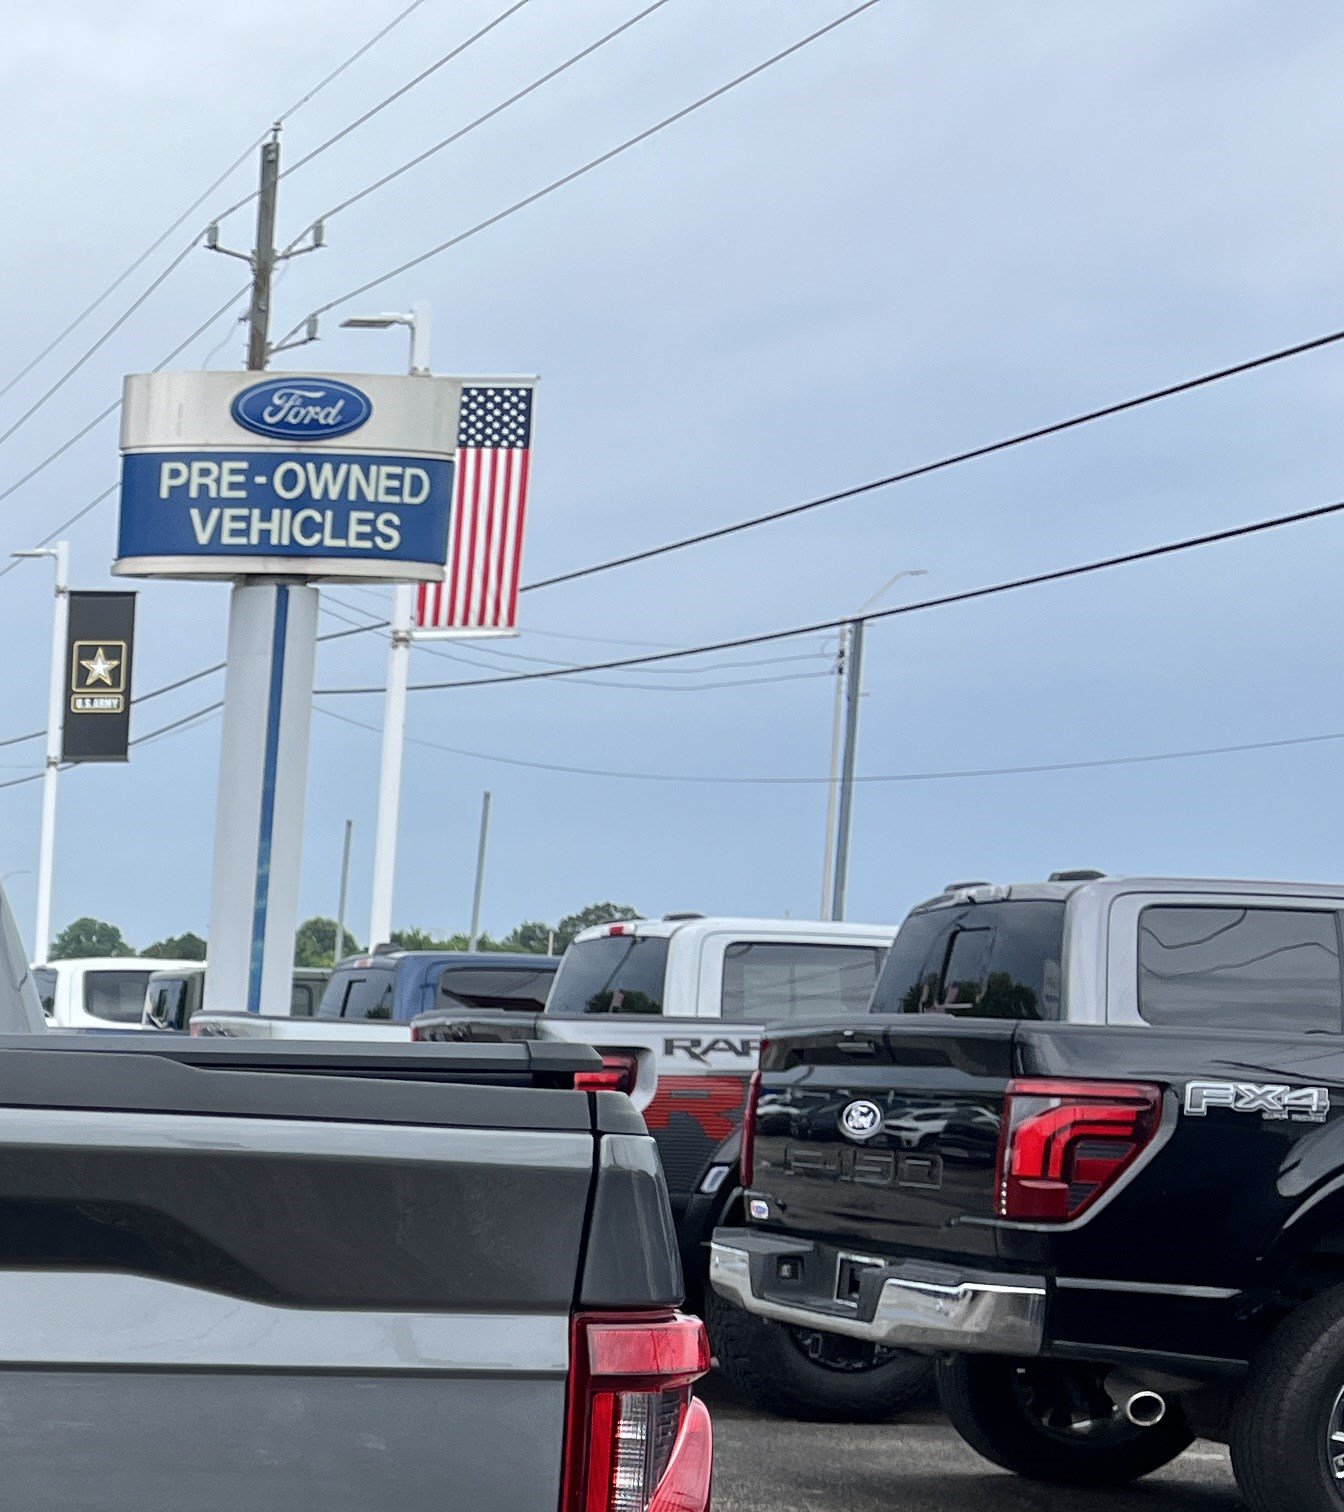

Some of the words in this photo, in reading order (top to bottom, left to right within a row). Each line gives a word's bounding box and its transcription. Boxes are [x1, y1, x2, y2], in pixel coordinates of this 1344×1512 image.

[262, 388, 345, 426] Ford
[159, 461, 430, 505] PRE-OWNED
[189, 507, 401, 551] VEHICLES
[1184, 1080, 1330, 1118] FX4
